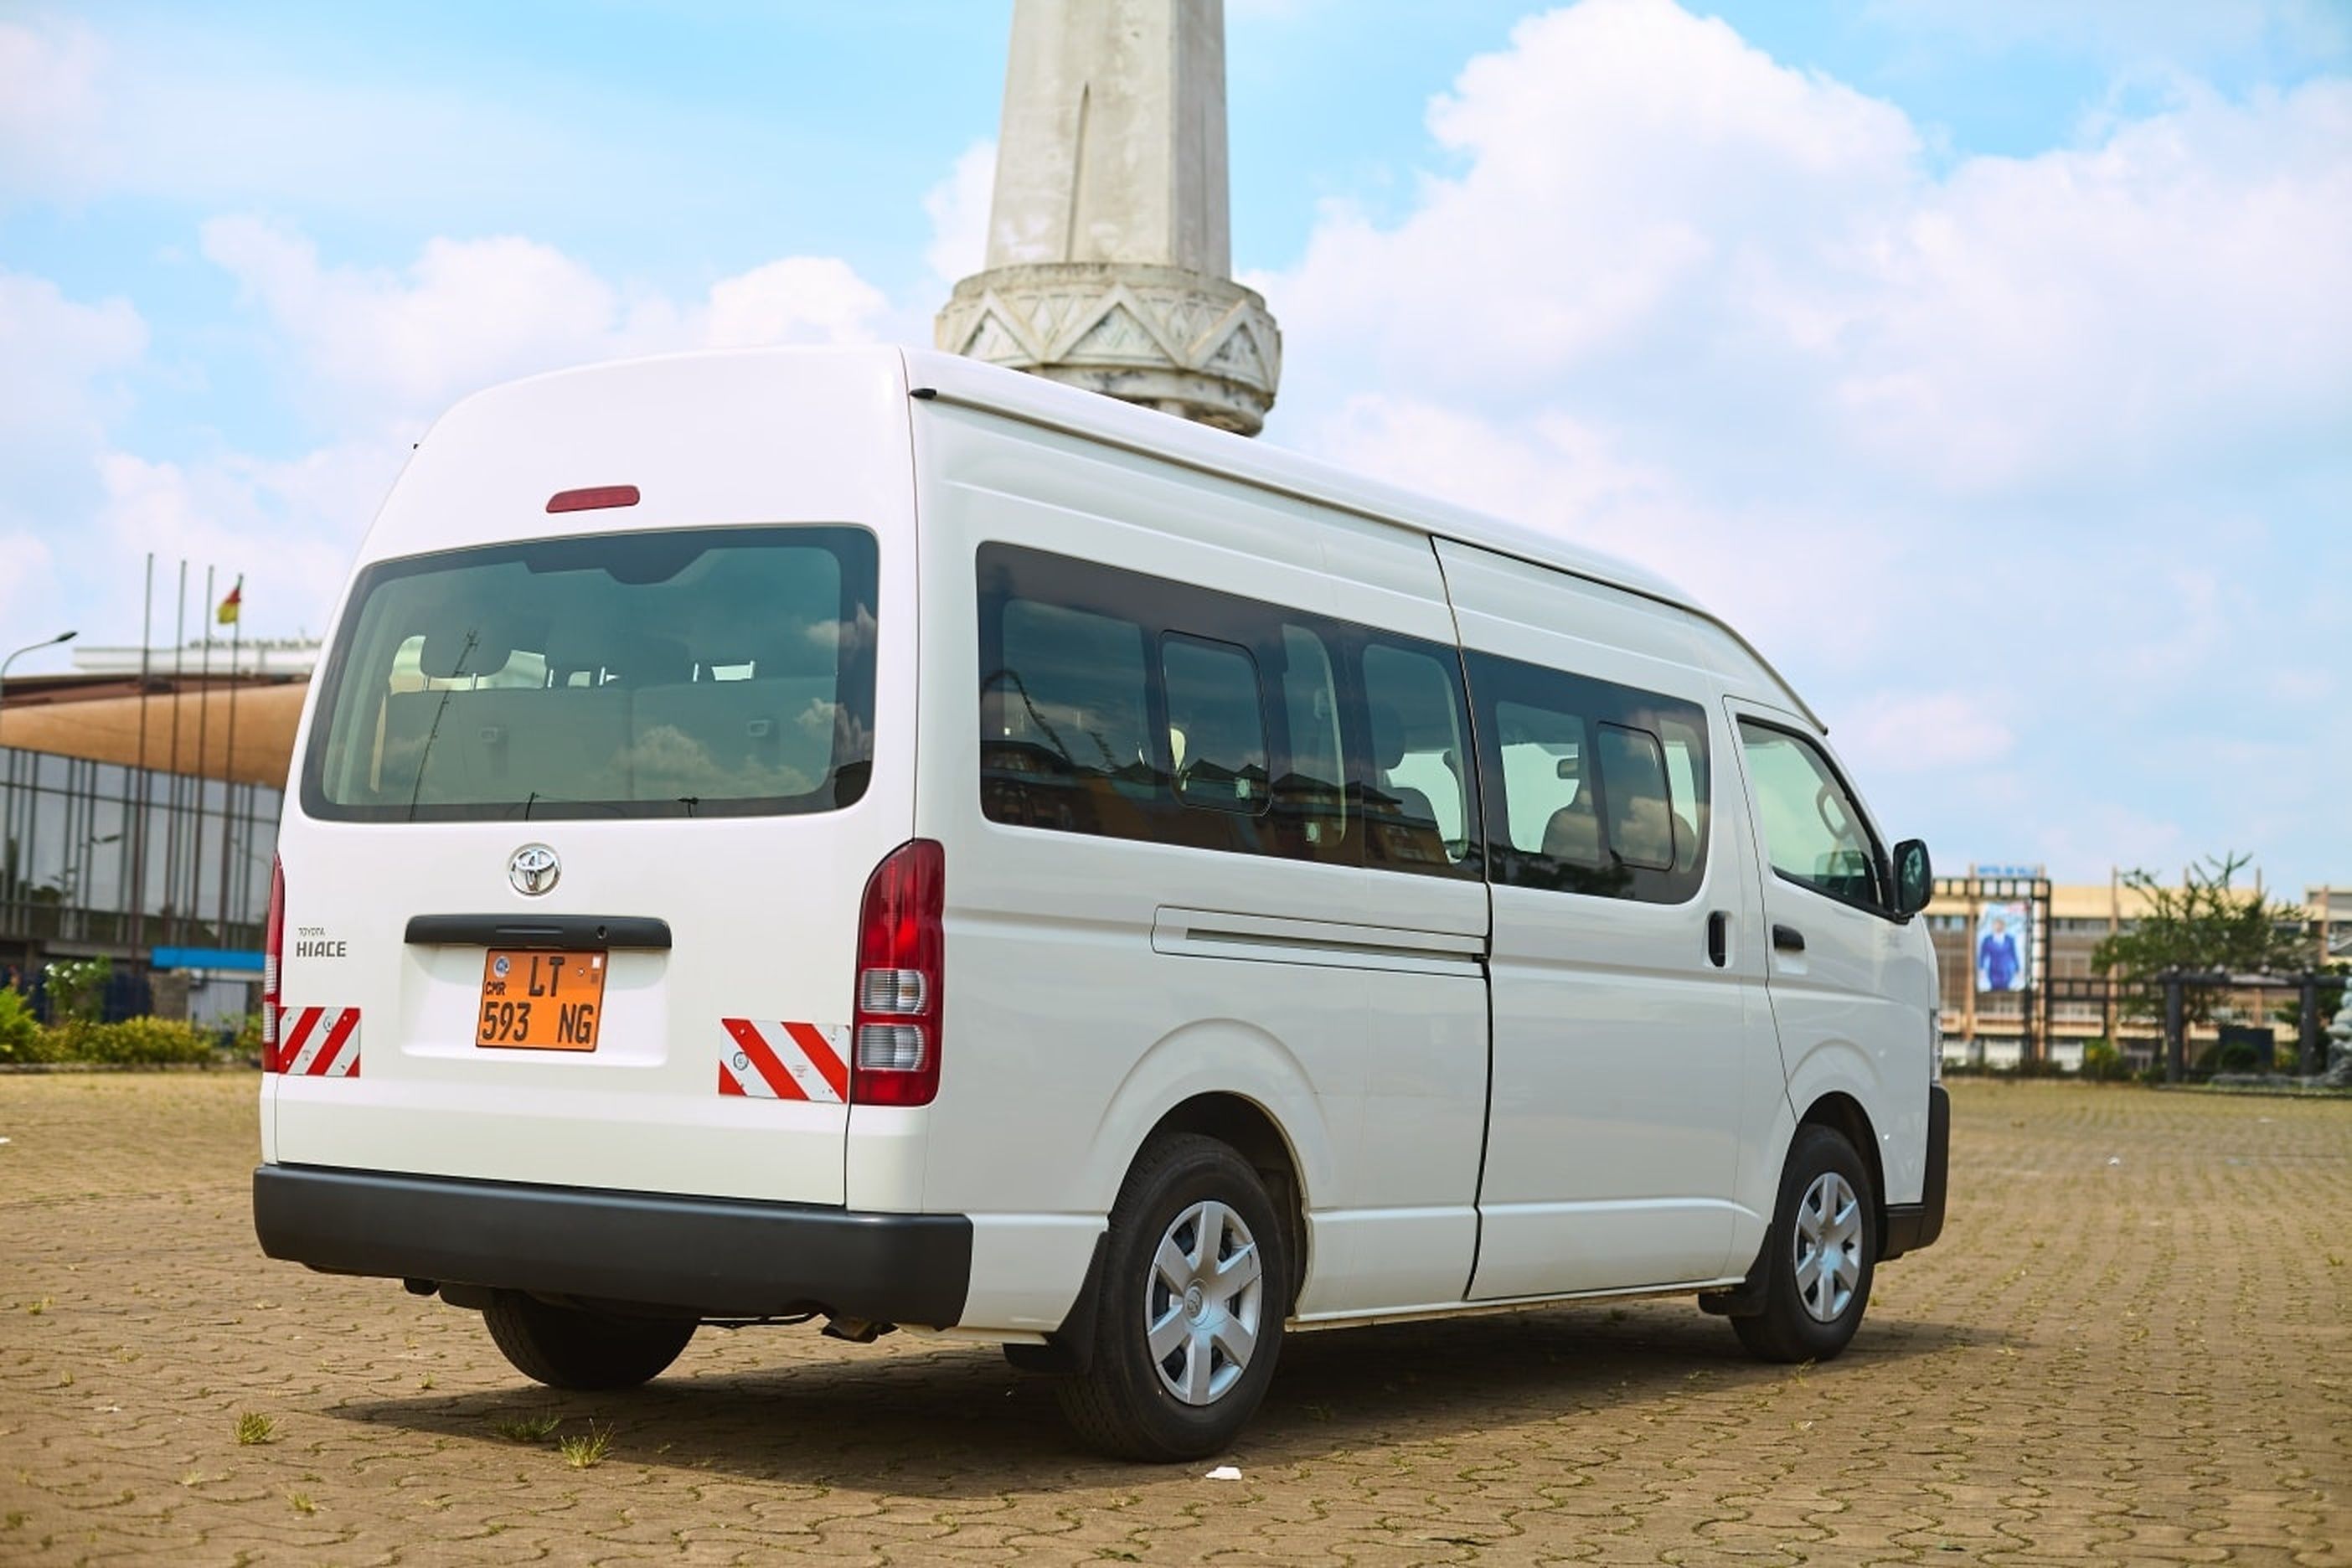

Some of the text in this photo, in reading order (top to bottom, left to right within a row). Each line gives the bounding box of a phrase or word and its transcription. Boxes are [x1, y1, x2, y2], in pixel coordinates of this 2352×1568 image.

[298, 927, 325, 936] TOYOTA
[297, 941, 347, 957] HIACE
[529, 956, 565, 997] LT
[485, 981, 507, 996] CMR
[482, 1001, 594, 1044] 593 NG
